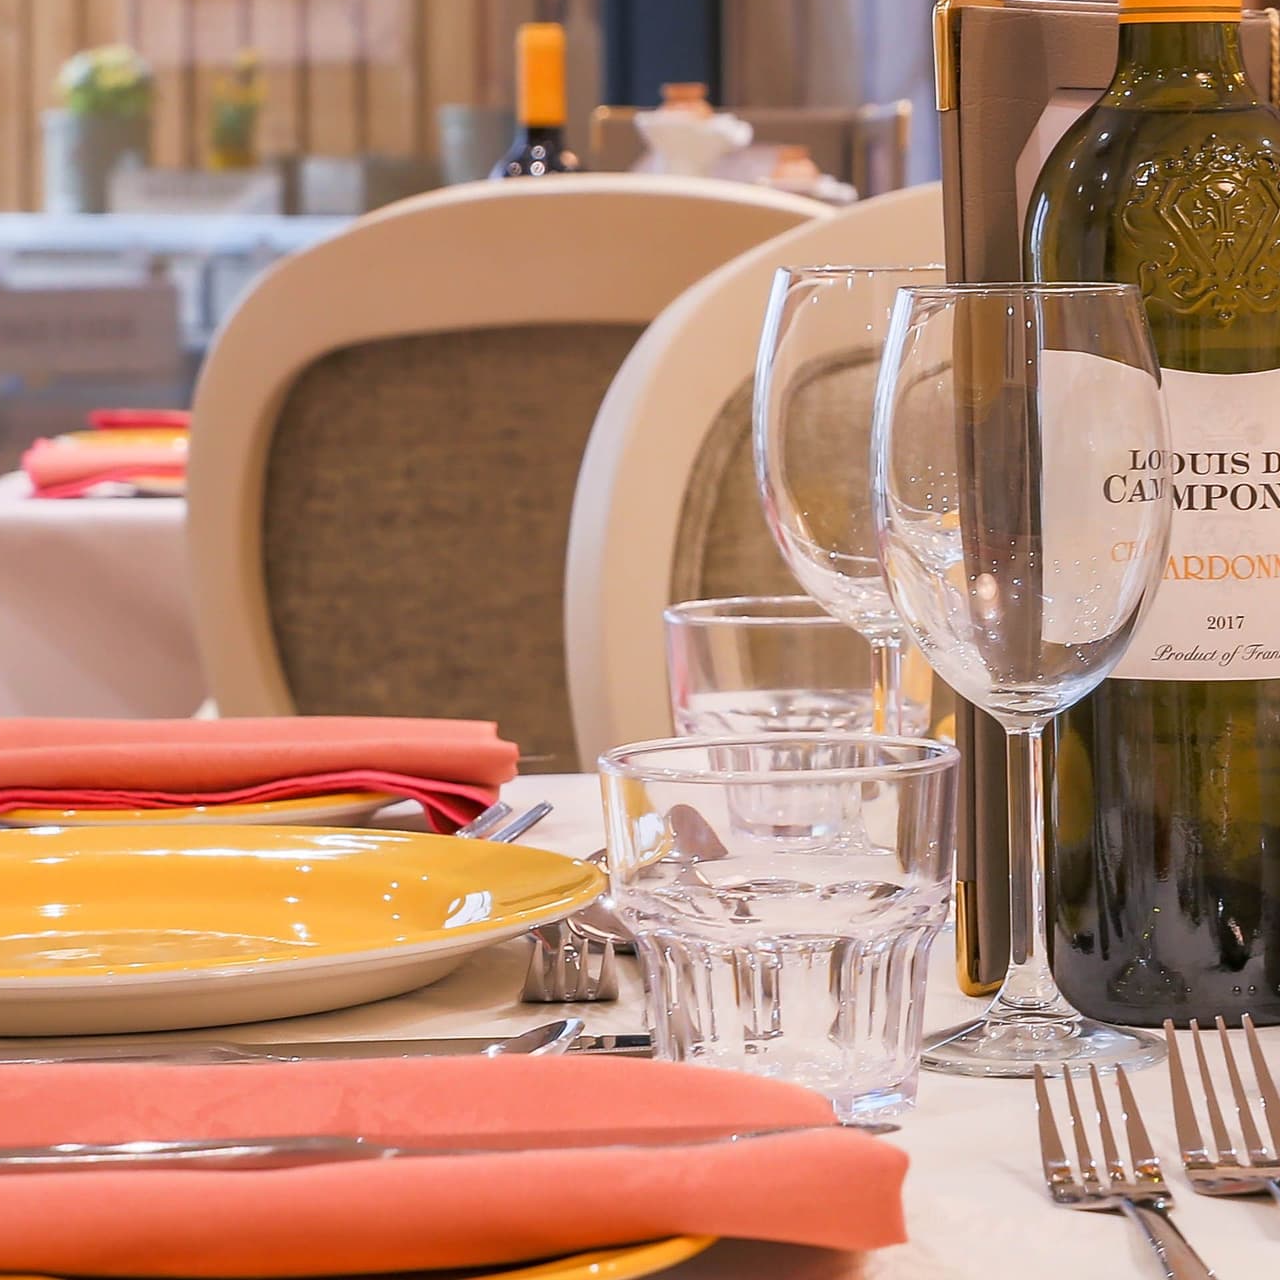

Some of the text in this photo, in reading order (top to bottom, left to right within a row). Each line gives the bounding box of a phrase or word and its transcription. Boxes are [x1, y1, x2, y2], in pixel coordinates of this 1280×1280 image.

[1128, 449, 1251, 475] LOUIS
[1206, 615, 1246, 630] 2017
[1150, 643, 1219, 662] Product
[1218, 644, 1244, 667] of
